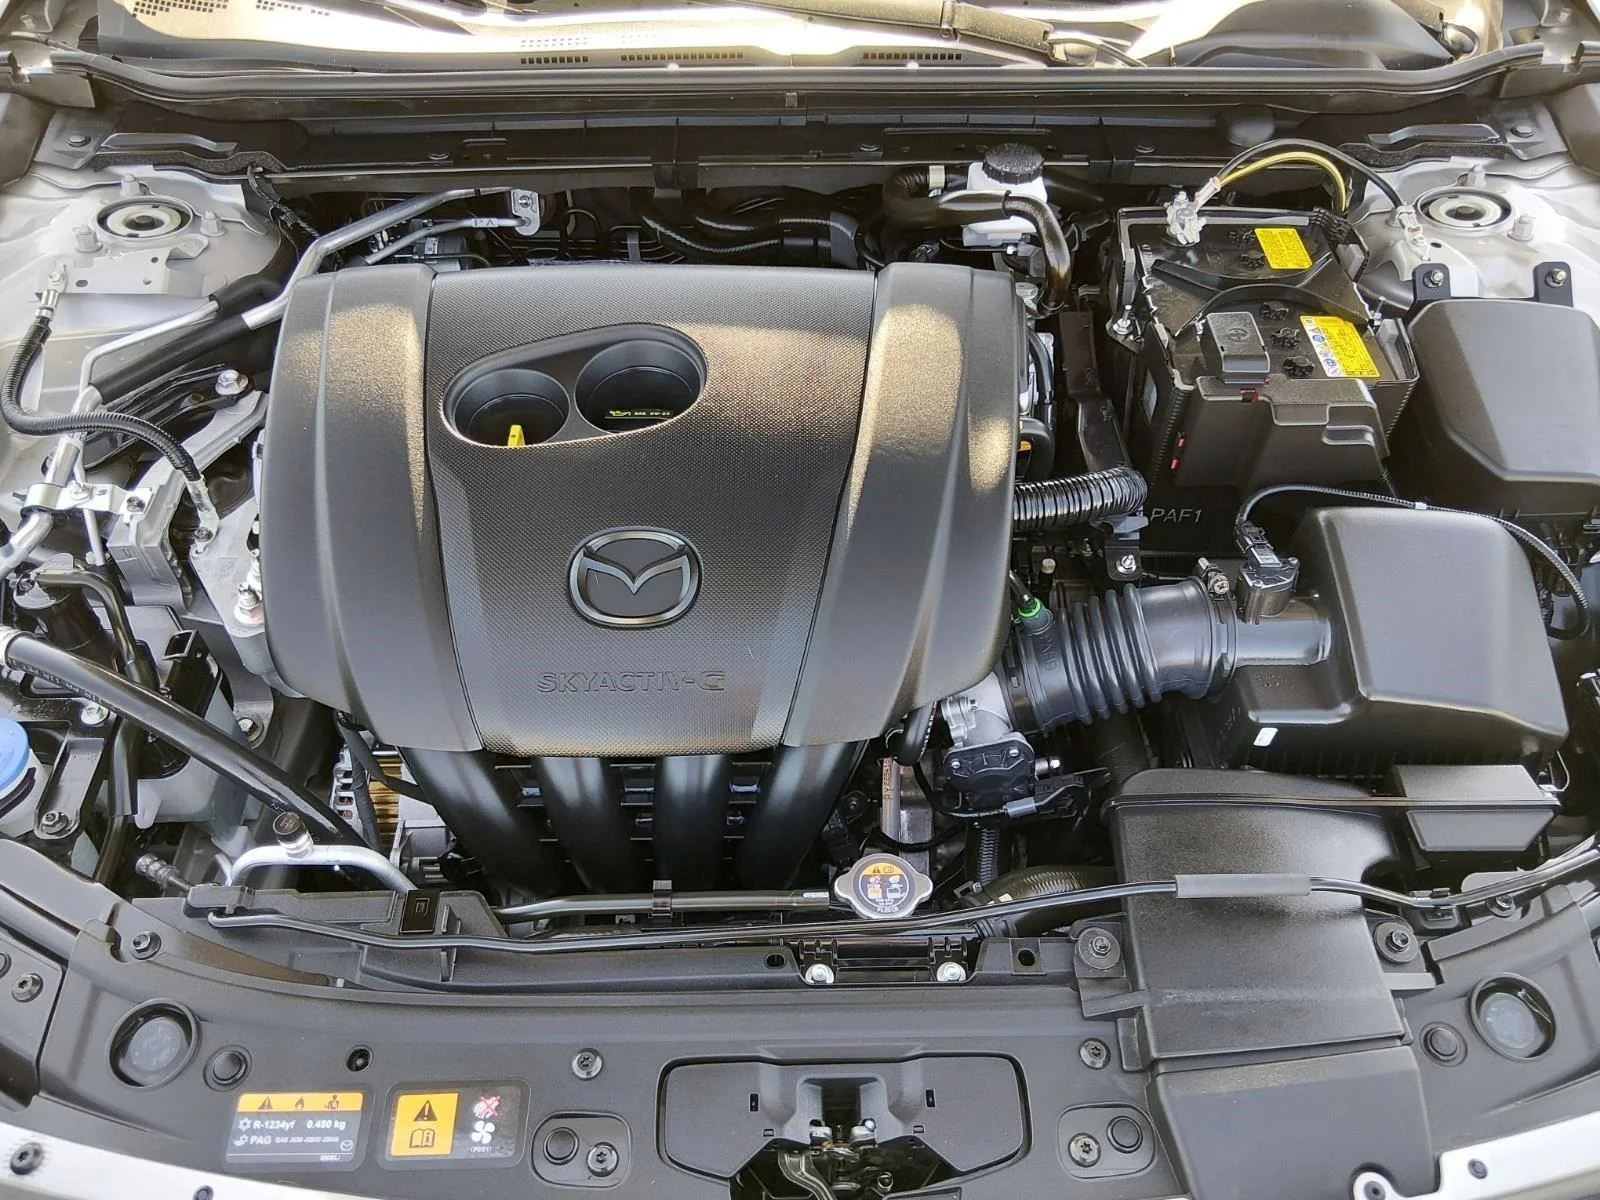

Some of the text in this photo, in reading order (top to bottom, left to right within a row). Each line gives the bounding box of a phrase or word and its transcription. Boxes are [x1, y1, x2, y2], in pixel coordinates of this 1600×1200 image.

[1150, 508, 1202, 522] PAF1
[537, 671, 725, 692] SKYACTIV-G
[253, 1120, 296, 1131] R-1234yf
[334, 1119, 346, 1130] kg
[249, 1135, 272, 1145] PAG
